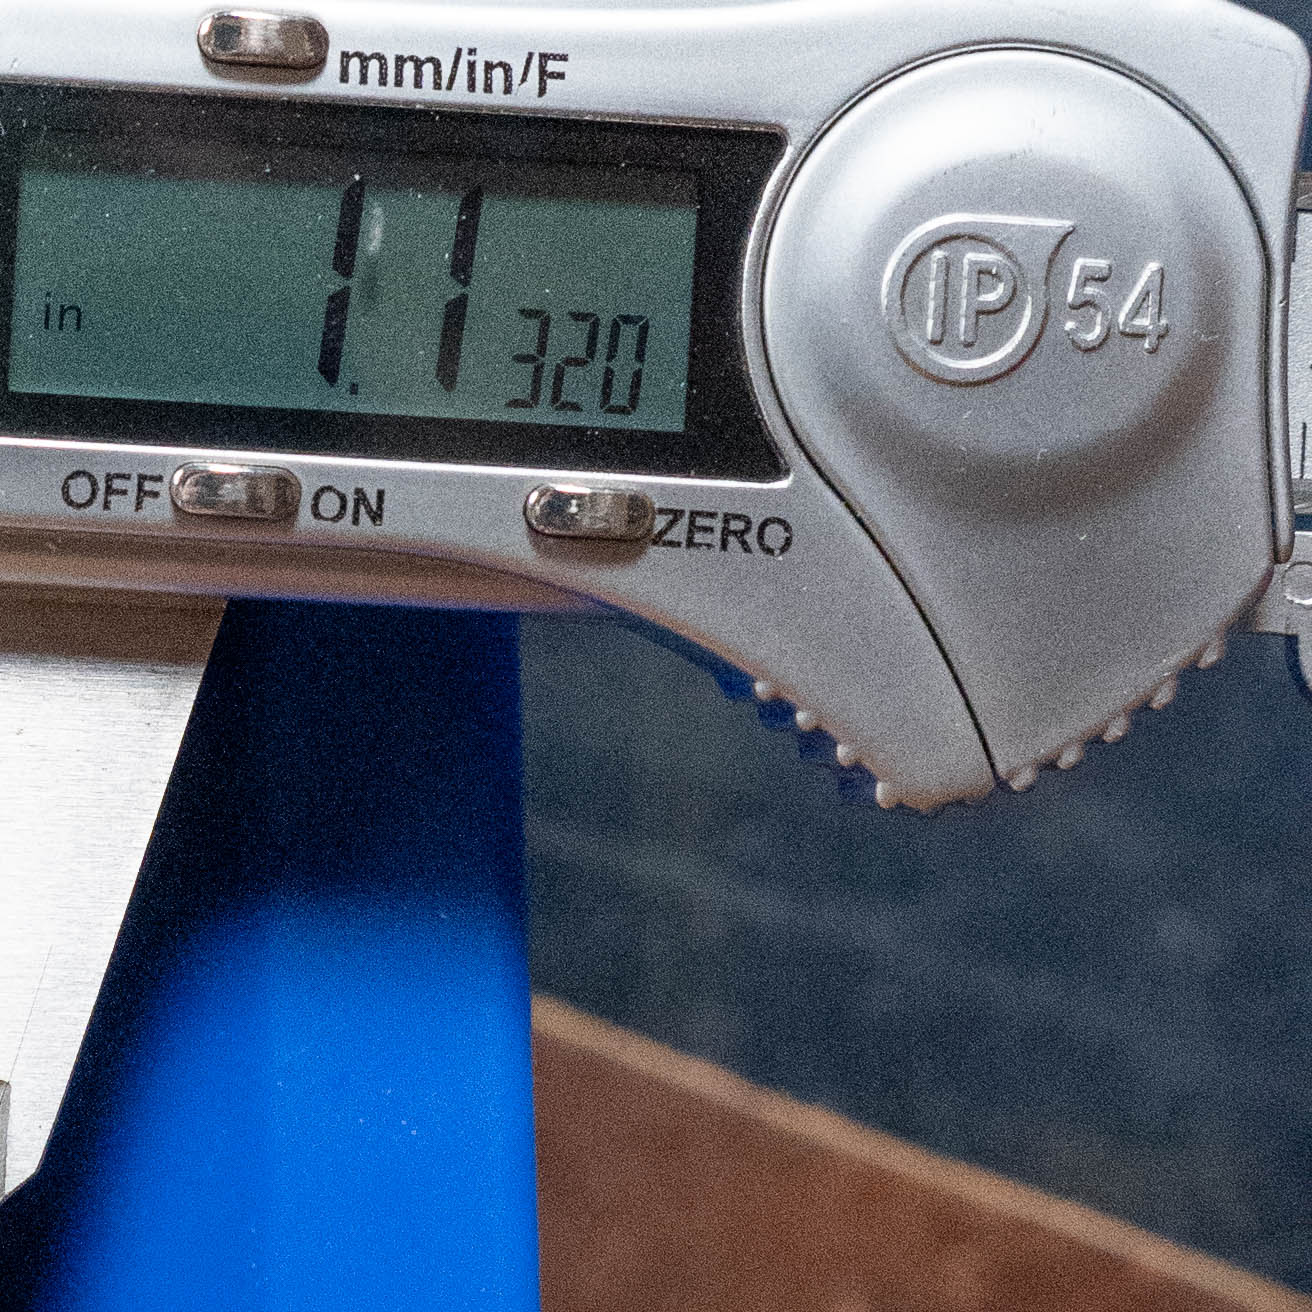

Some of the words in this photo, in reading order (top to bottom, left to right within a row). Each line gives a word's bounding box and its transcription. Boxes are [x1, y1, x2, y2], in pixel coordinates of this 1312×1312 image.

[339, 47, 569, 98] mm/in/F
[42, 291, 83, 332] in
[61, 469, 164, 512] OFF
[310, 486, 386, 527] ON
[650, 507, 793, 556] ZERO
